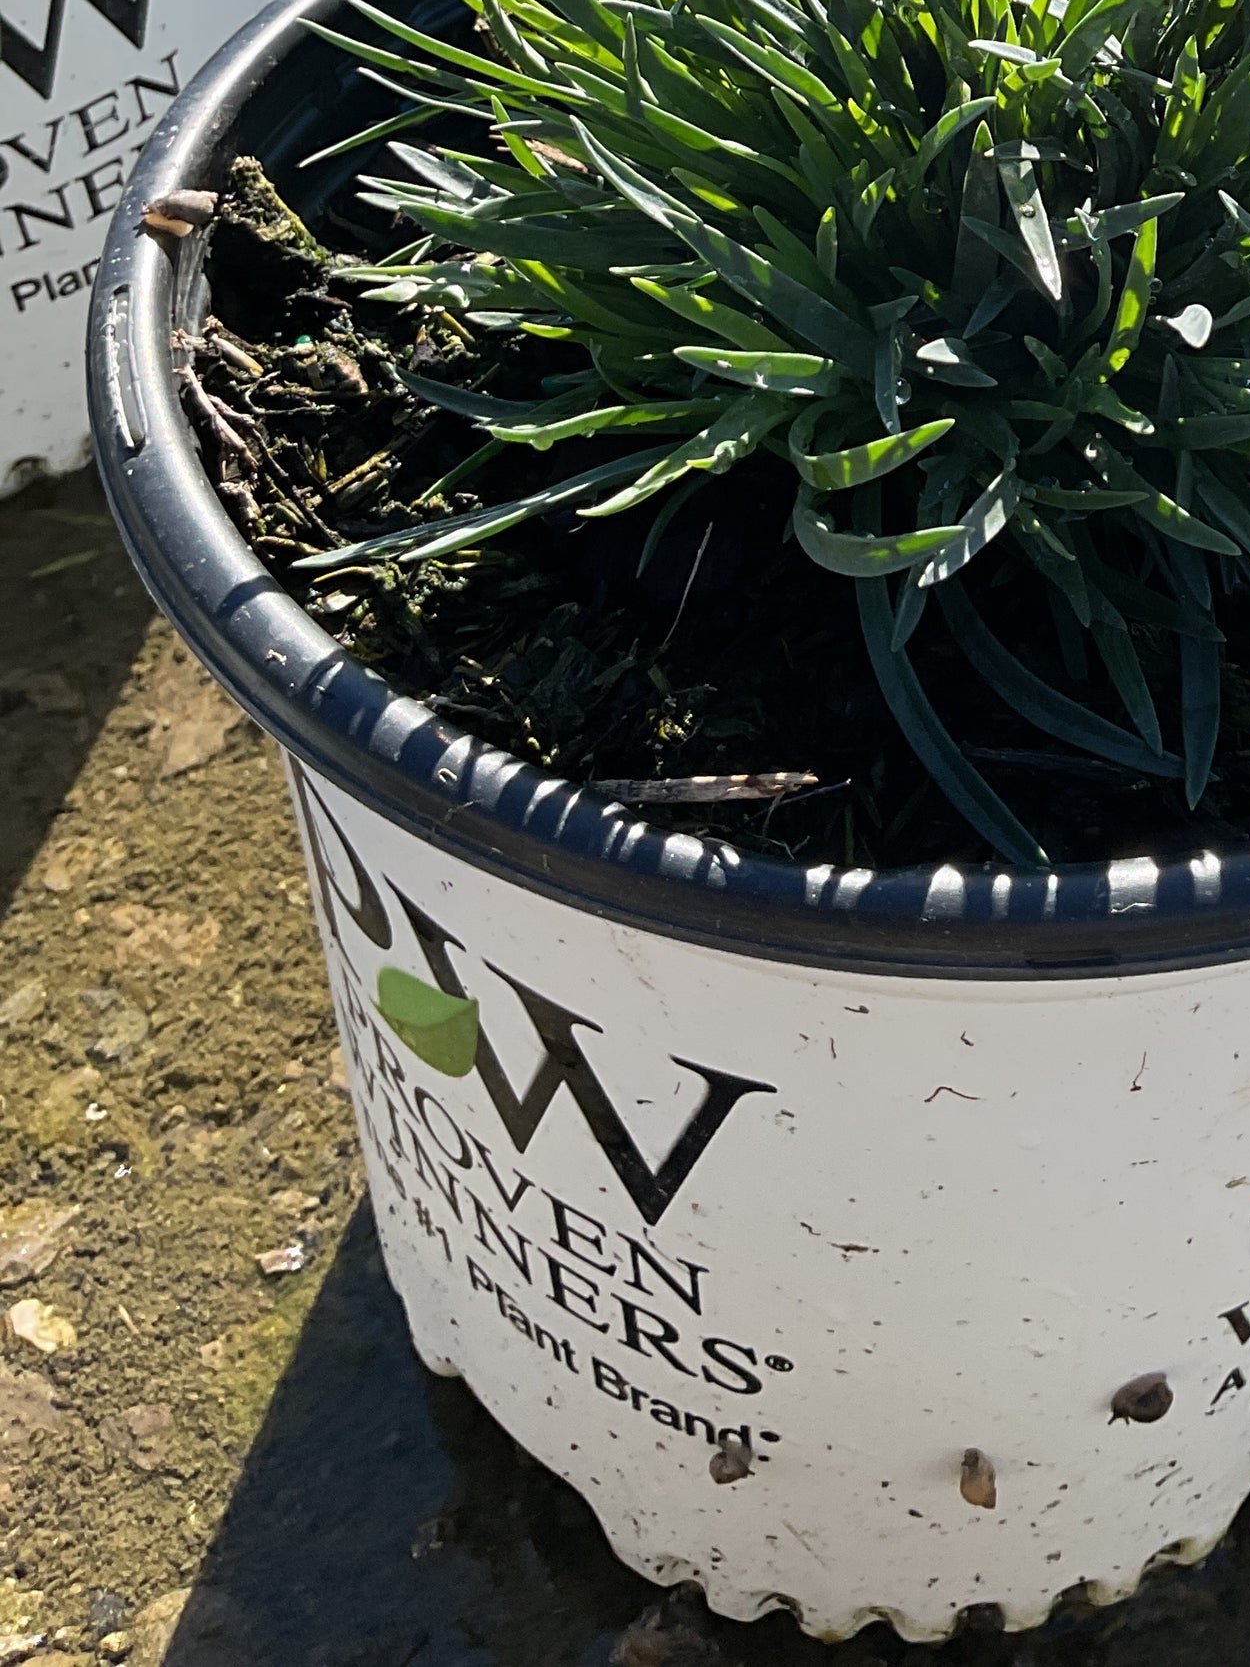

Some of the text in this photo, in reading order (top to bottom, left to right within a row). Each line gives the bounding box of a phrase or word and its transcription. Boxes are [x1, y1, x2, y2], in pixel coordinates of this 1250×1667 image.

[0, 48, 181, 184] VEN
[10, 255, 101, 313] Plan
[287, 750, 778, 1226] PW
[338, 959, 707, 1316] PROVEN
[412, 1195, 453, 1263] #1
[469, 1263, 579, 1375] Plant
[1210, 1367, 1247, 1406] A
